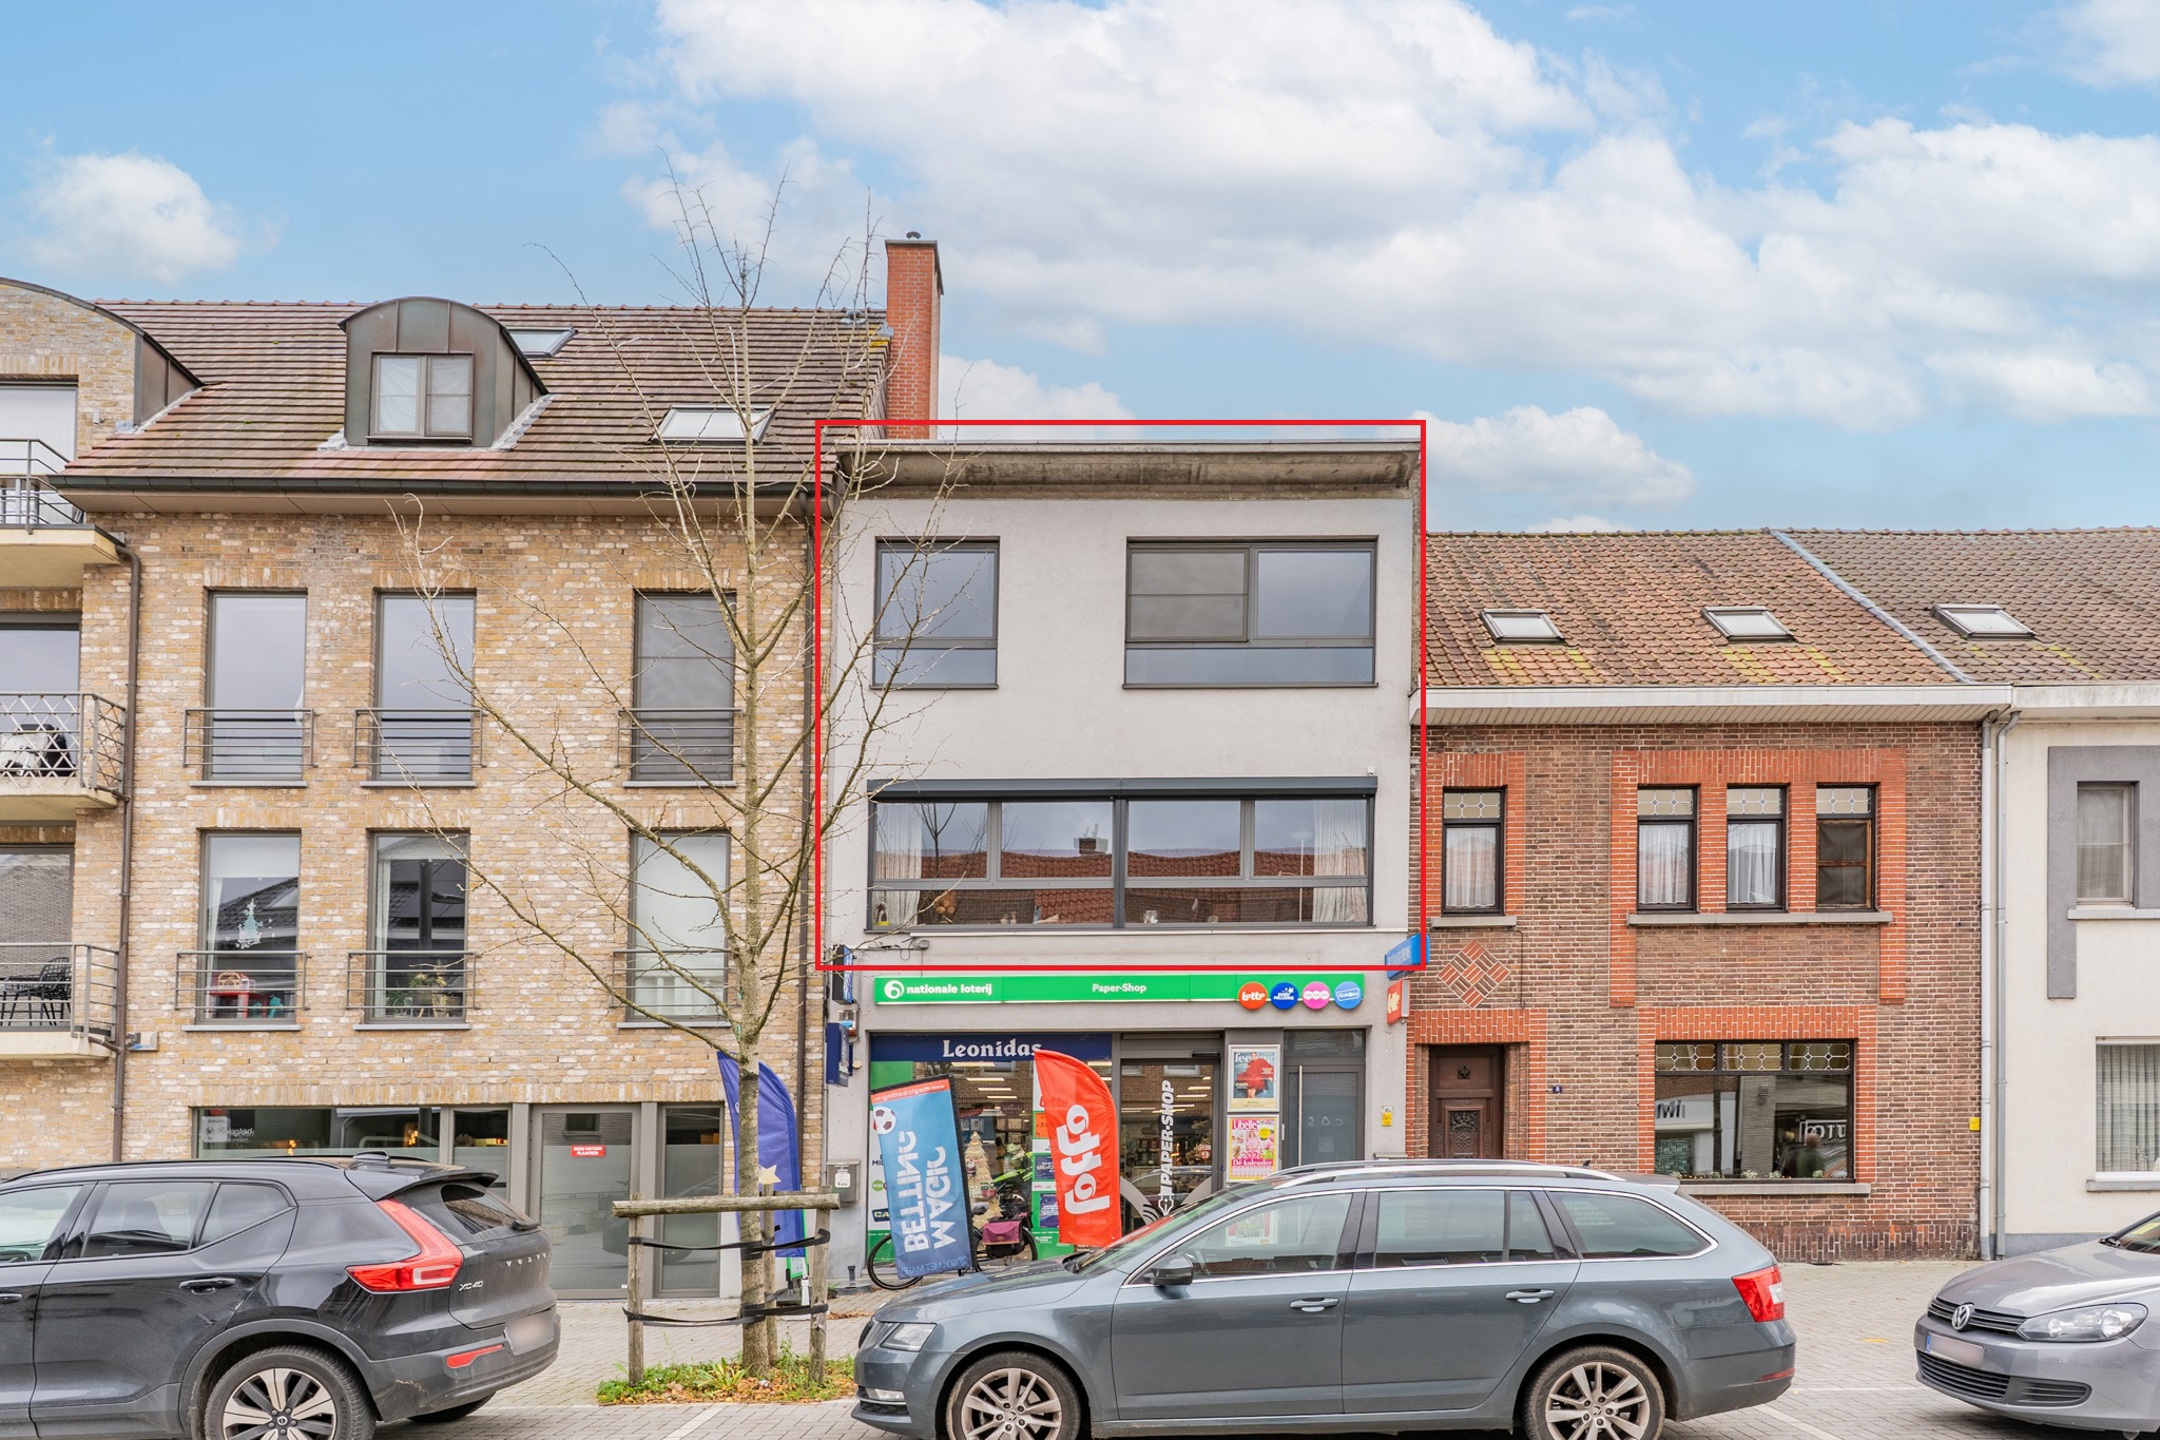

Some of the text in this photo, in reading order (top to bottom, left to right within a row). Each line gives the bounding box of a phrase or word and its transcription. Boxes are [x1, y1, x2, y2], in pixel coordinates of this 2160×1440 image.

[906, 983, 993, 996] nationale loterij
[1092, 983, 1147, 994] Paper-Shop
[1242, 991, 1266, 1001] Lotto
[942, 1039, 1042, 1058] Leonidas
[459, 1280, 484, 1291] XC40
